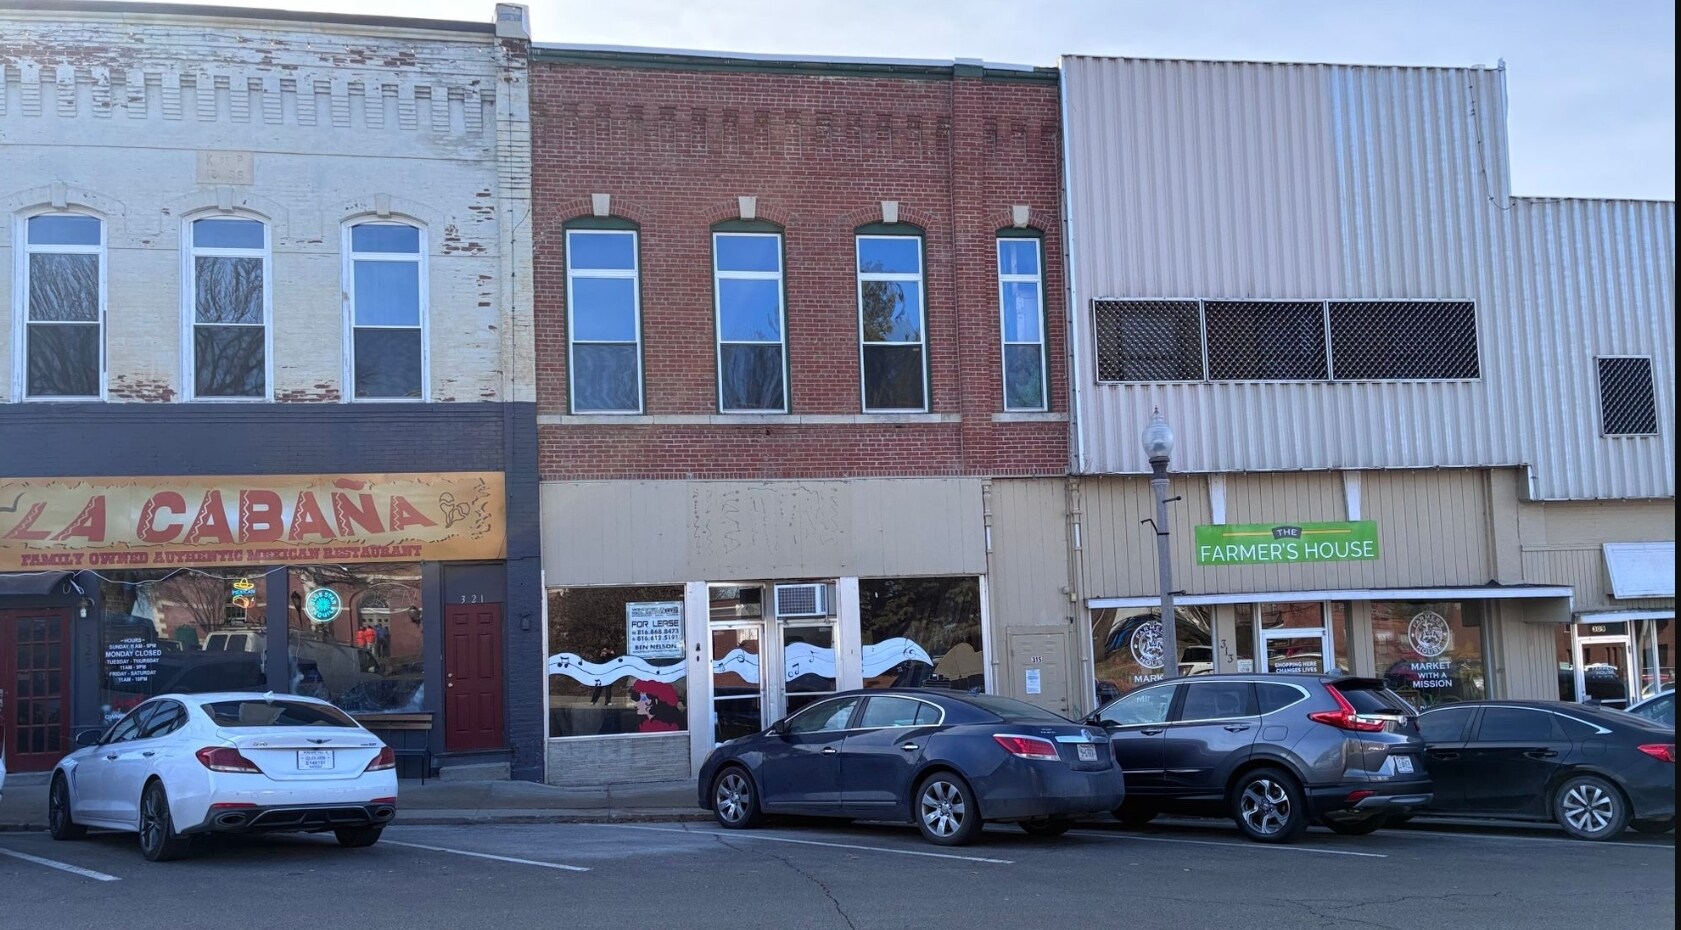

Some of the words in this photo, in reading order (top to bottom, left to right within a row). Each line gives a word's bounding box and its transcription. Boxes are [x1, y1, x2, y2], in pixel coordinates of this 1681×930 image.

[1, 495, 106, 542] LA
[136, 478, 438, 544] CABAÑA
[1276, 528, 1298, 537] THE
[21, 552, 85, 566] FAMILY
[89, 551, 148, 565] OWNED
[153, 549, 243, 564] AUTHENTIC
[246, 546, 321, 561] MEXICAN
[323, 544, 423, 560] RESTAURANT
[1201, 542, 1299, 562] FARMER'S
[1304, 540, 1375, 559] HOUSE
[653, 620, 679, 628] LEASE
[1416, 644, 1444, 654] HOUSE
[1411, 662, 1452, 671] MARKET
[1412, 679, 1453, 689] MISSION
